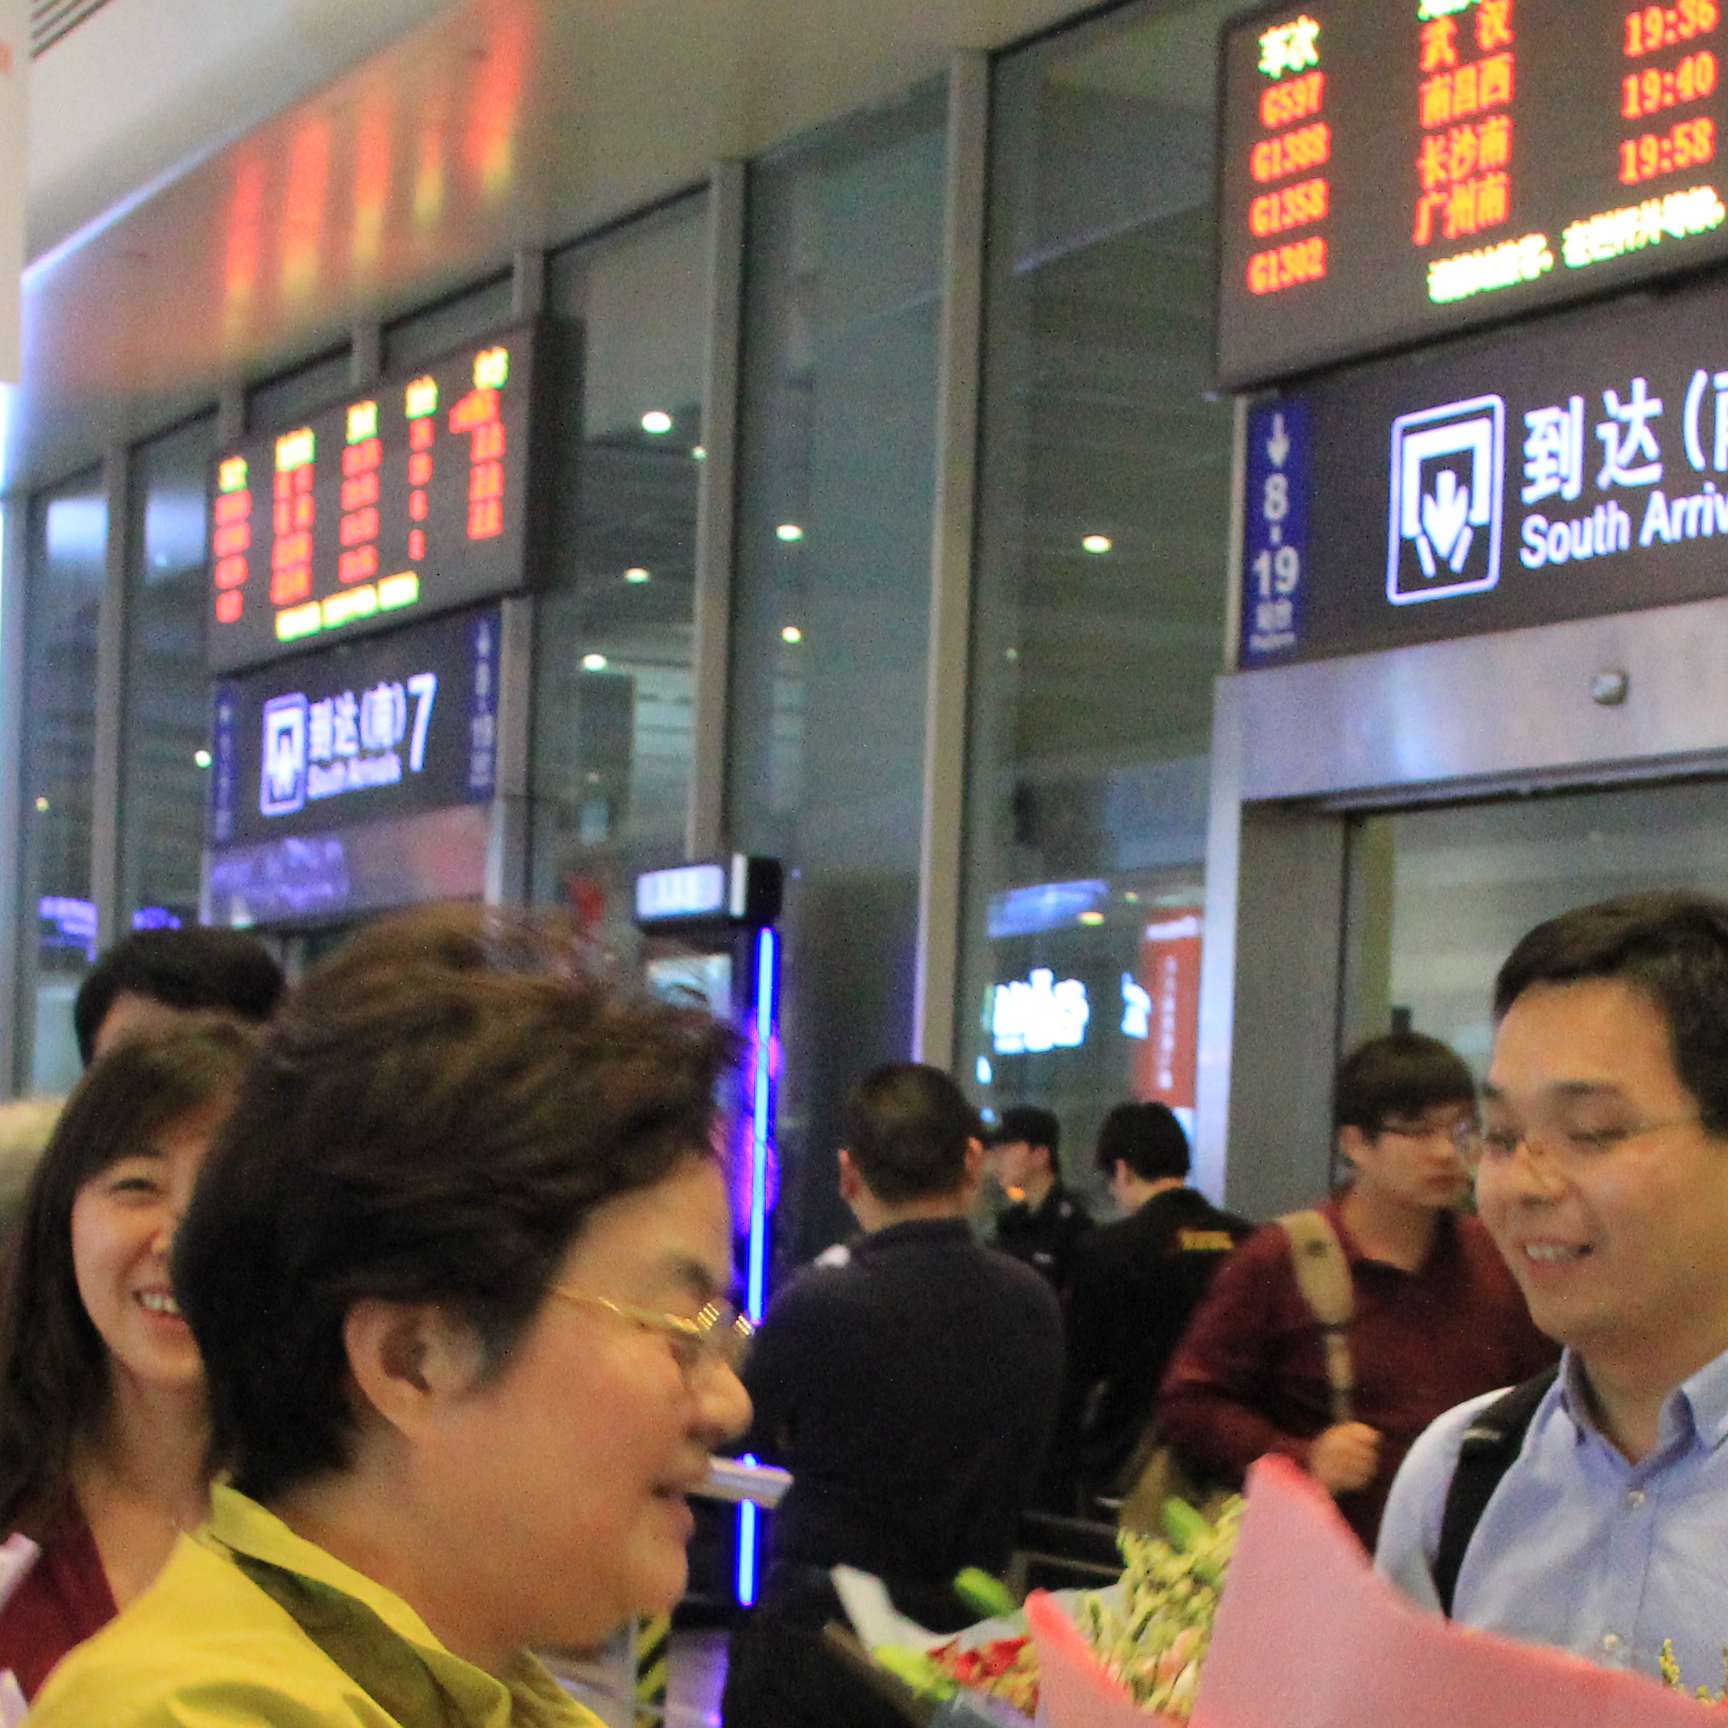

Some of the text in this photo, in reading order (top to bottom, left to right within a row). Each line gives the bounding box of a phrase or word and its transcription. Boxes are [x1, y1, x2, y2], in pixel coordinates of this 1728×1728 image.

[1419, 51, 1516, 129] 南昌西
[1621, 51, 1718, 120] 19:40
[1619, 117, 1716, 186] 19:58
[1413, 172, 1510, 246] 广州南
[1264, 473, 1289, 522] 8
[1520, 500, 1630, 569] South
[1253, 545, 1300, 597] 19
[407, 673, 437, 772] 7
